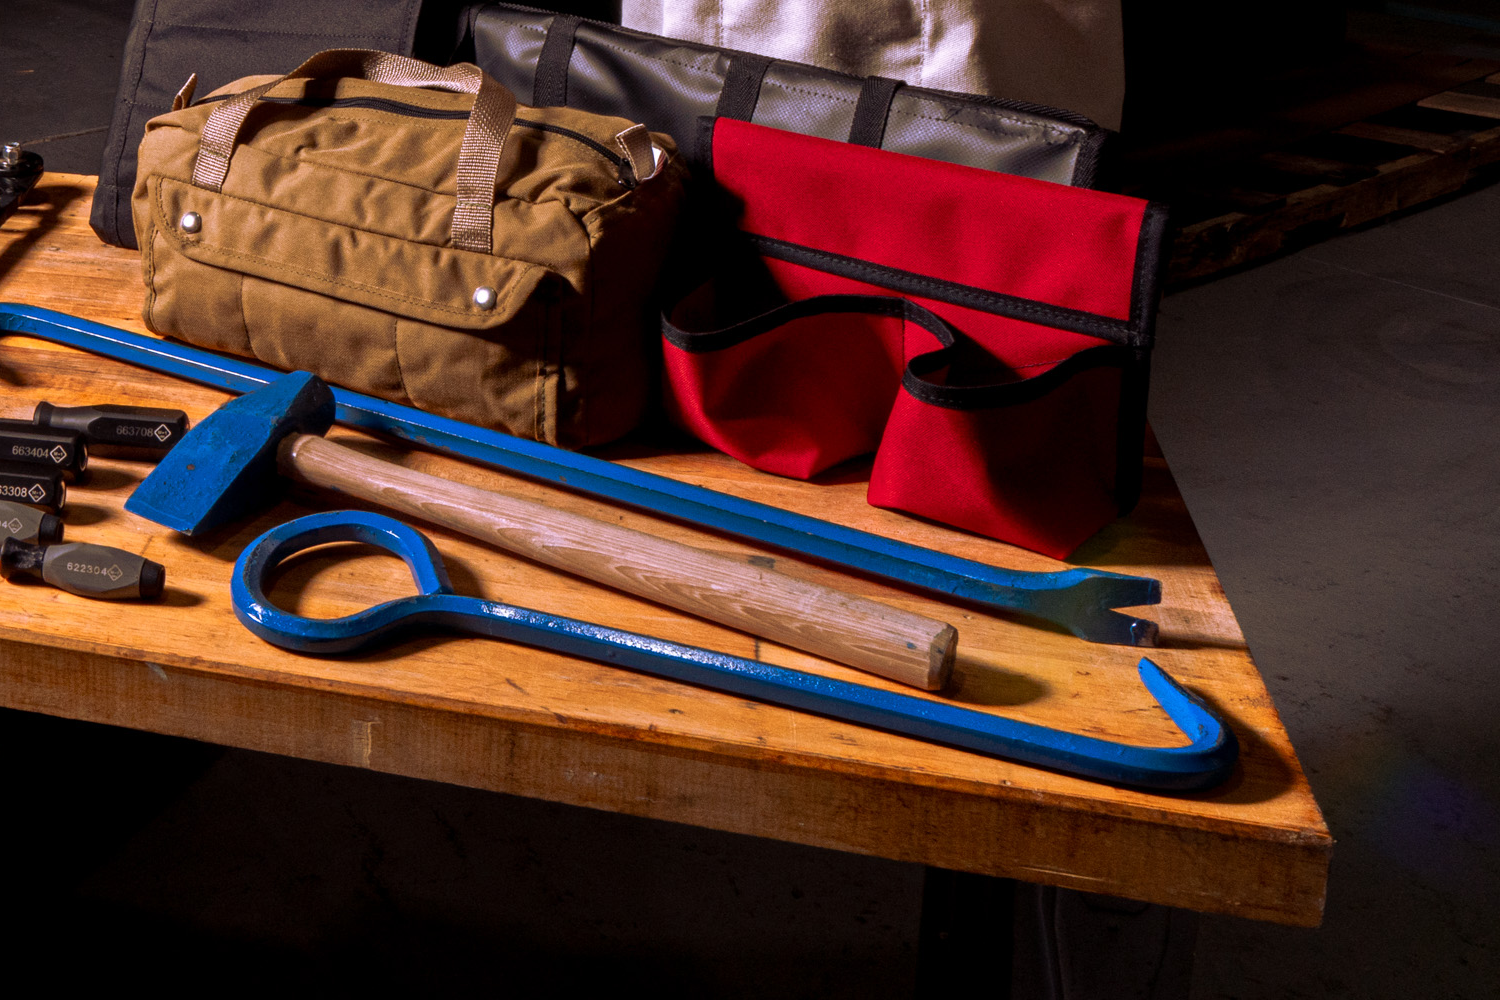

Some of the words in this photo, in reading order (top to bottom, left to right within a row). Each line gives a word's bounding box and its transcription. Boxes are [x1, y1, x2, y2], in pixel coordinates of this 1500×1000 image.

[116, 425, 154, 437] 663708
[12, 445, 49, 458] 663404
[66, 561, 107, 576] 622304
